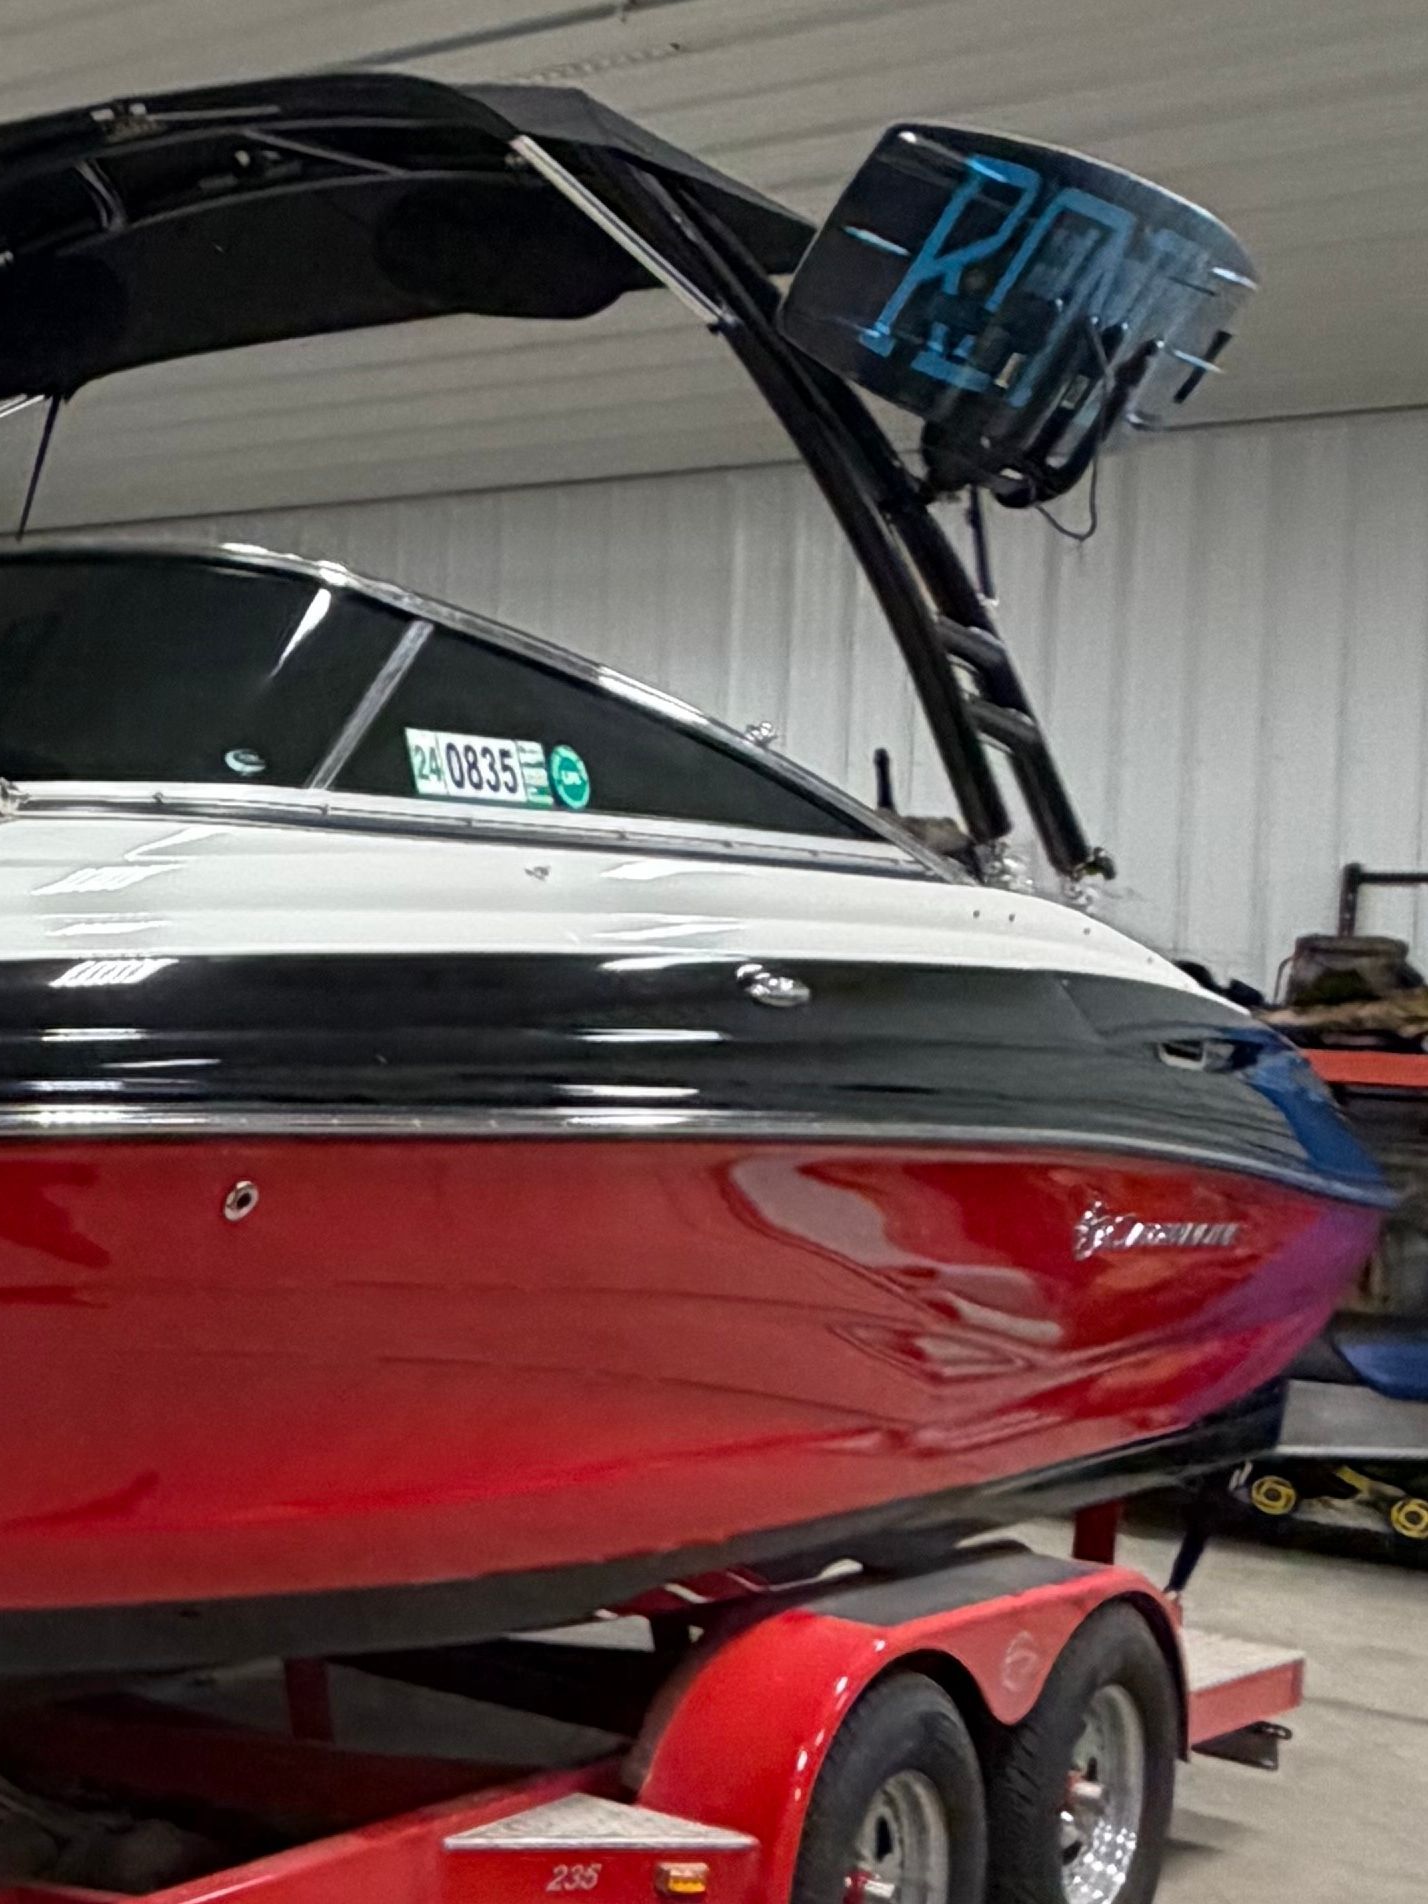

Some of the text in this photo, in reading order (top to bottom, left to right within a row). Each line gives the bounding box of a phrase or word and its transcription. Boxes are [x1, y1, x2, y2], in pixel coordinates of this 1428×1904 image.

[413, 743, 443, 782] 24
[444, 741, 519, 794] 0835
[545, 1863, 603, 1893] 235
